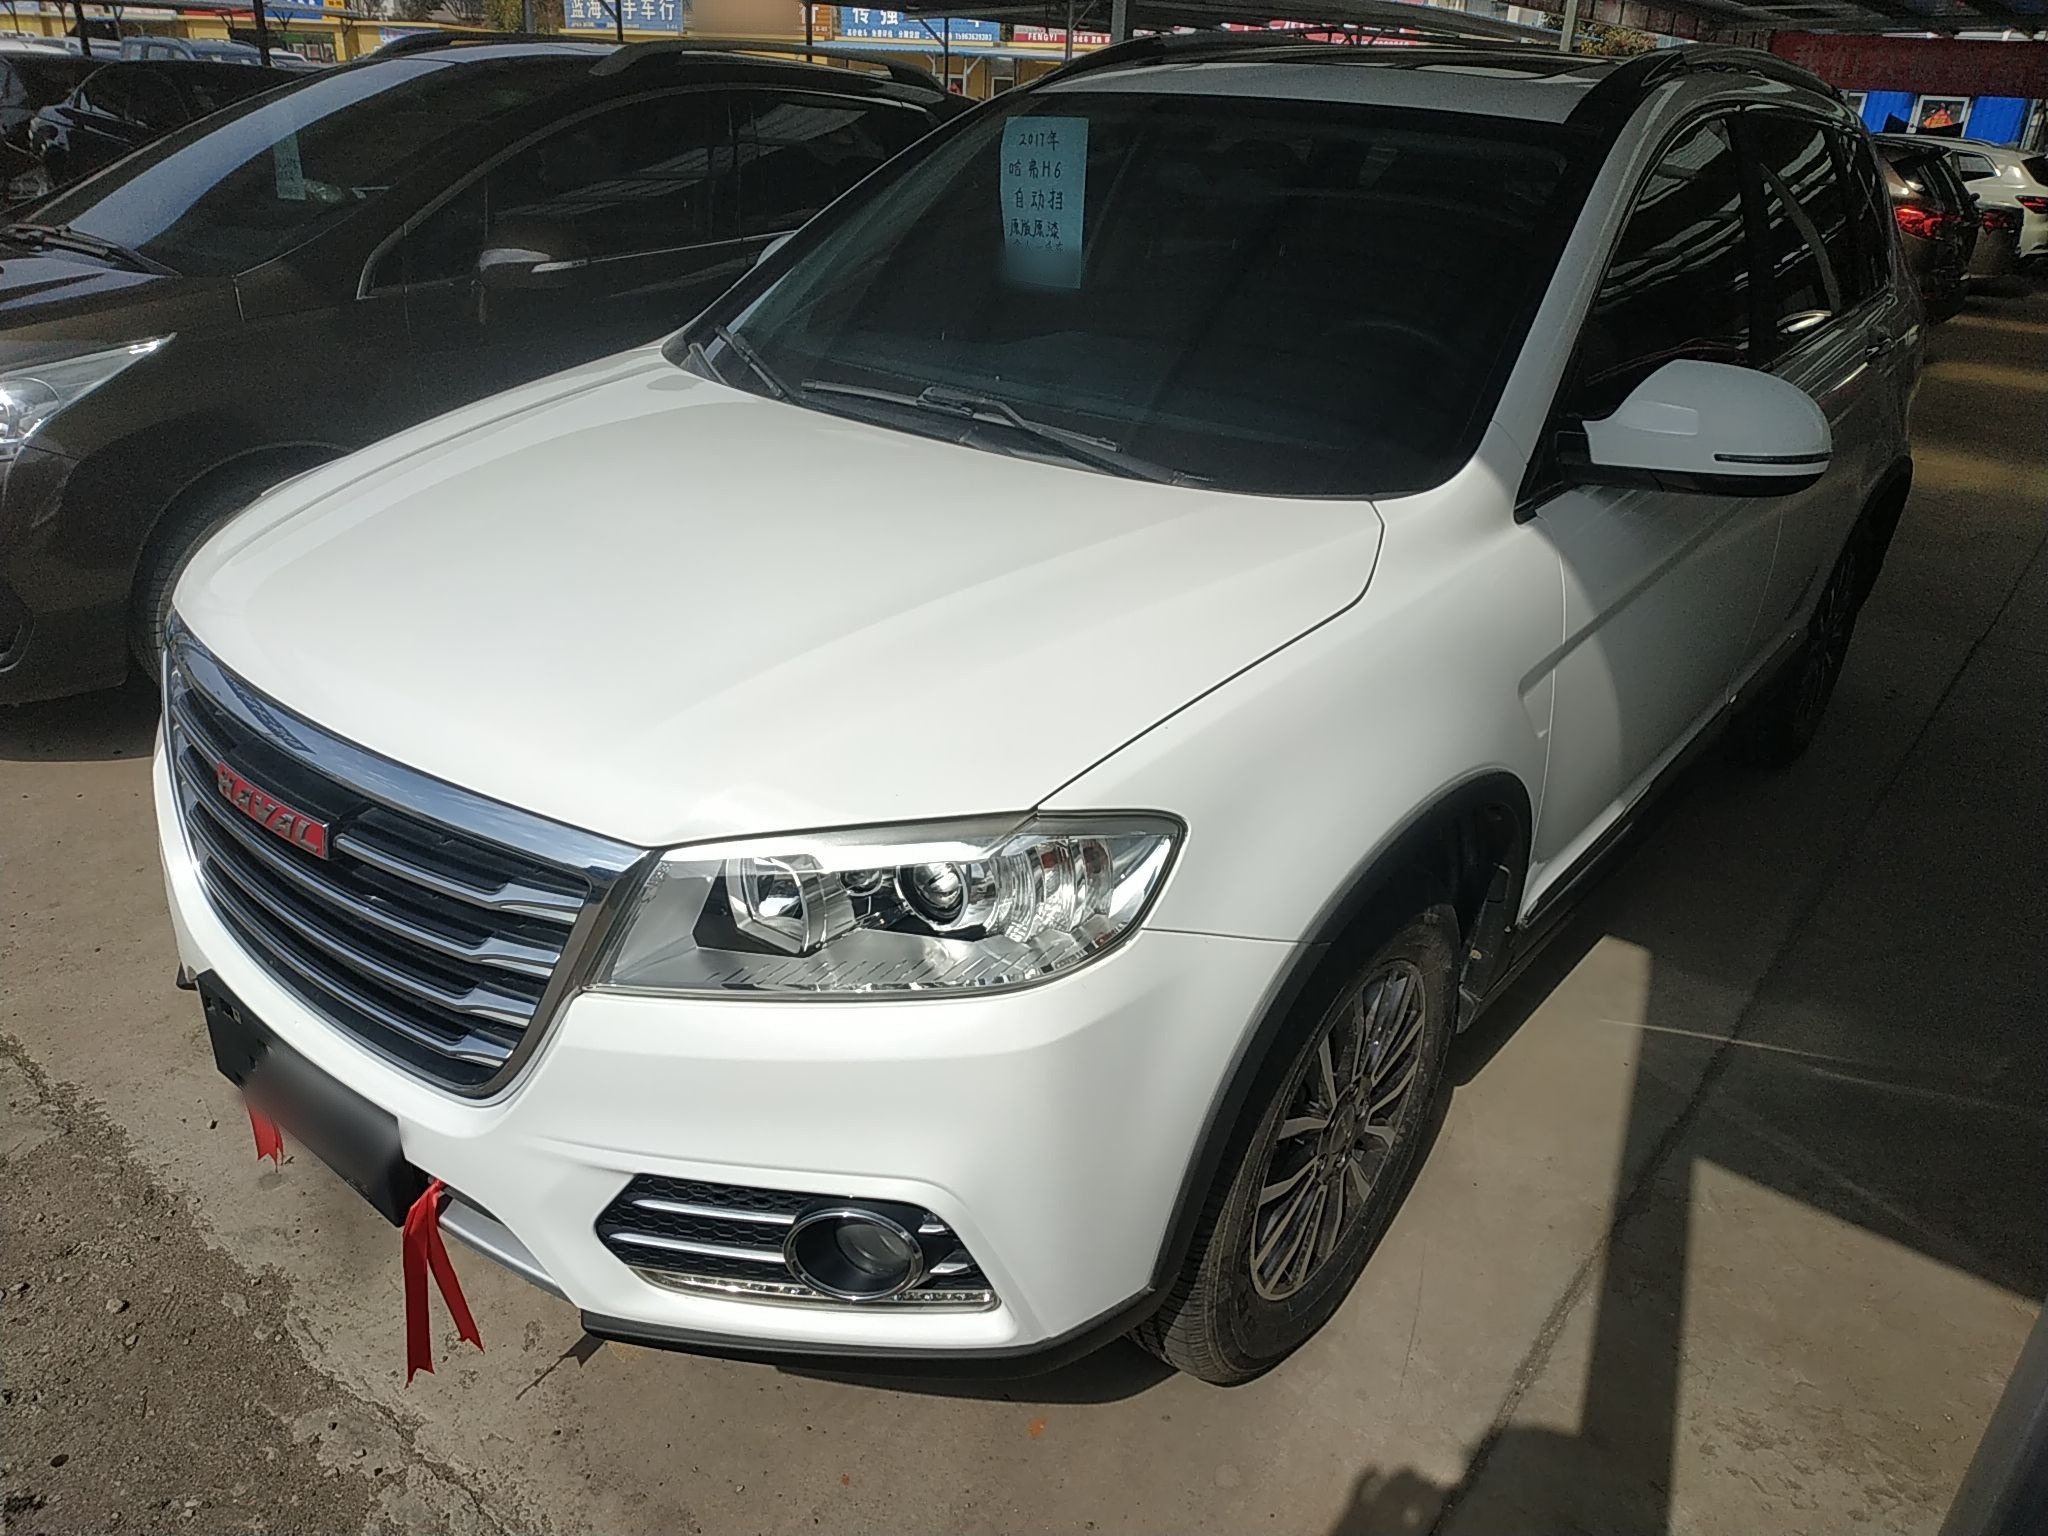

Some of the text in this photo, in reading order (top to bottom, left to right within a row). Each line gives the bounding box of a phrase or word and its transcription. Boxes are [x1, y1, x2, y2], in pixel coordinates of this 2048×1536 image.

[1028, 32, 1058, 42] FENGYI
[1018, 130, 1061, 151] 2017年
[219, 767, 319, 854] HAVAL
